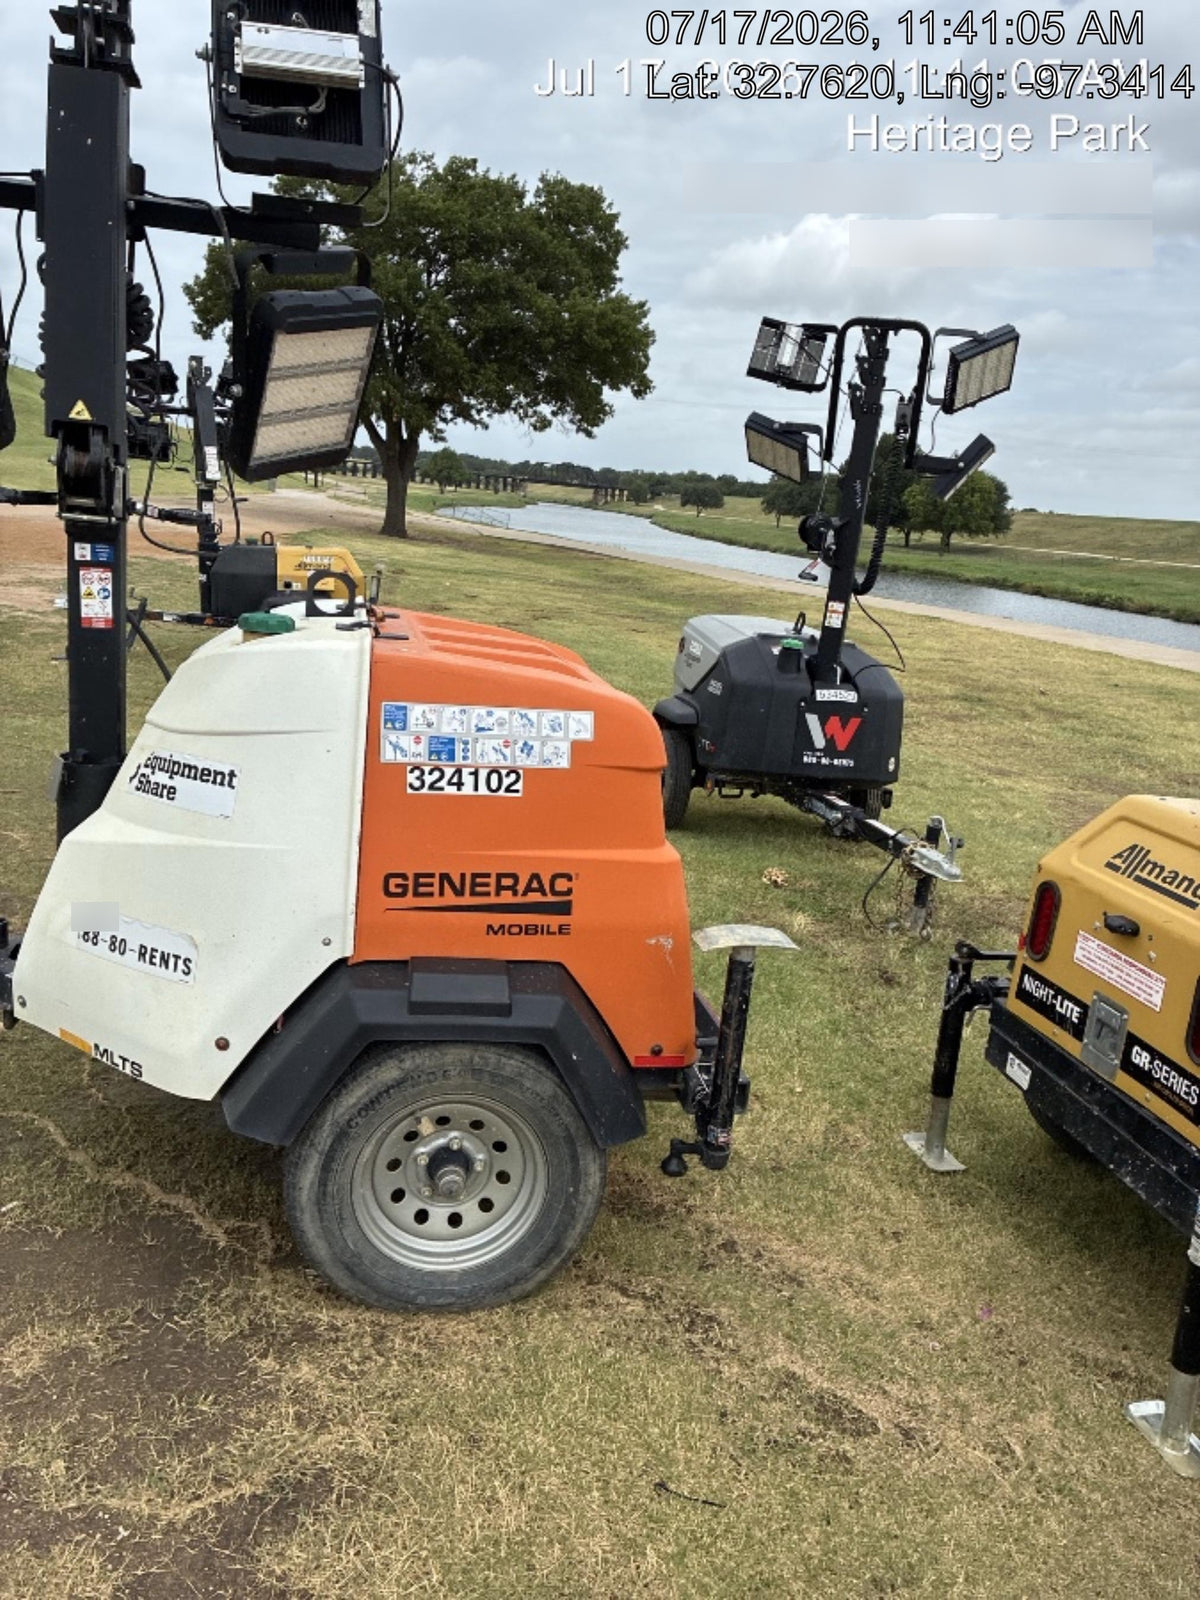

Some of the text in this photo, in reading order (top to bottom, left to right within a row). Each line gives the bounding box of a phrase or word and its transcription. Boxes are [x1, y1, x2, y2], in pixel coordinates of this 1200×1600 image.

[135, 772, 177, 802] Share
[407, 766, 523, 794] 324102
[382, 872, 574, 898] GENERAC
[486, 924, 572, 936] MOBILE
[1021, 973, 1081, 1024] NIGHT-LITE
[93, 1042, 143, 1079] MLTS
[1130, 1045, 1200, 1106] GR-SERIES
